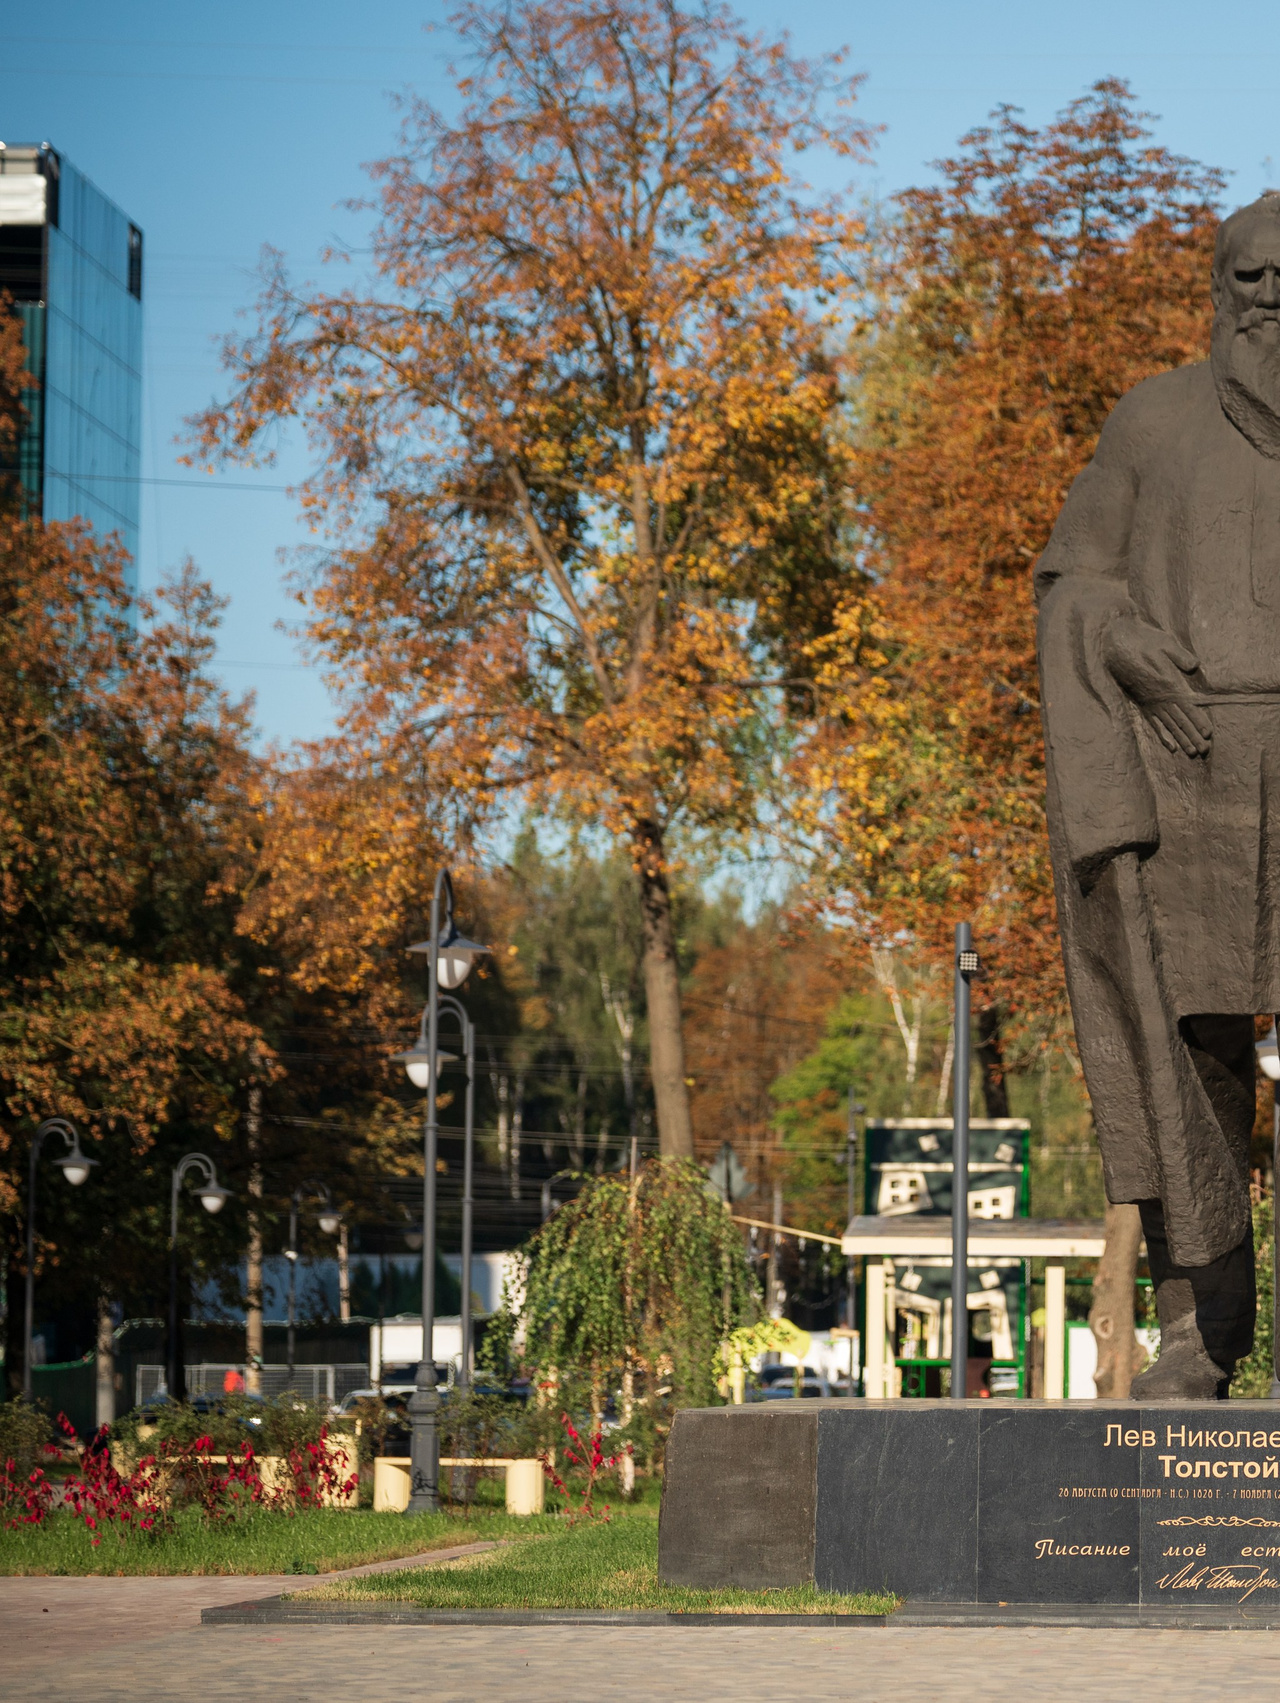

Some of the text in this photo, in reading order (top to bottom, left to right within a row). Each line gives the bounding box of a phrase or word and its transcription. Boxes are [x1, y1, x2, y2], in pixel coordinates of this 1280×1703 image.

[1103, 1424, 1157, 1448] Лев
[1158, 1455, 1280, 1478] Толстой
[1058, 1487, 1069, 1498] 28
[1071, 1487, 1107, 1498] АВГУСТА
[1109, 1487, 1119, 1499] (9
[1121, 1488, 1162, 1498] СЕНТЯБРЯ
[1192, 1489, 1213, 1499] 1828
[1240, 1489, 1272, 1499] НОЯБРЯ
[1034, 1539, 1131, 1560] Писание
[1162, 1543, 1207, 1557] моё
